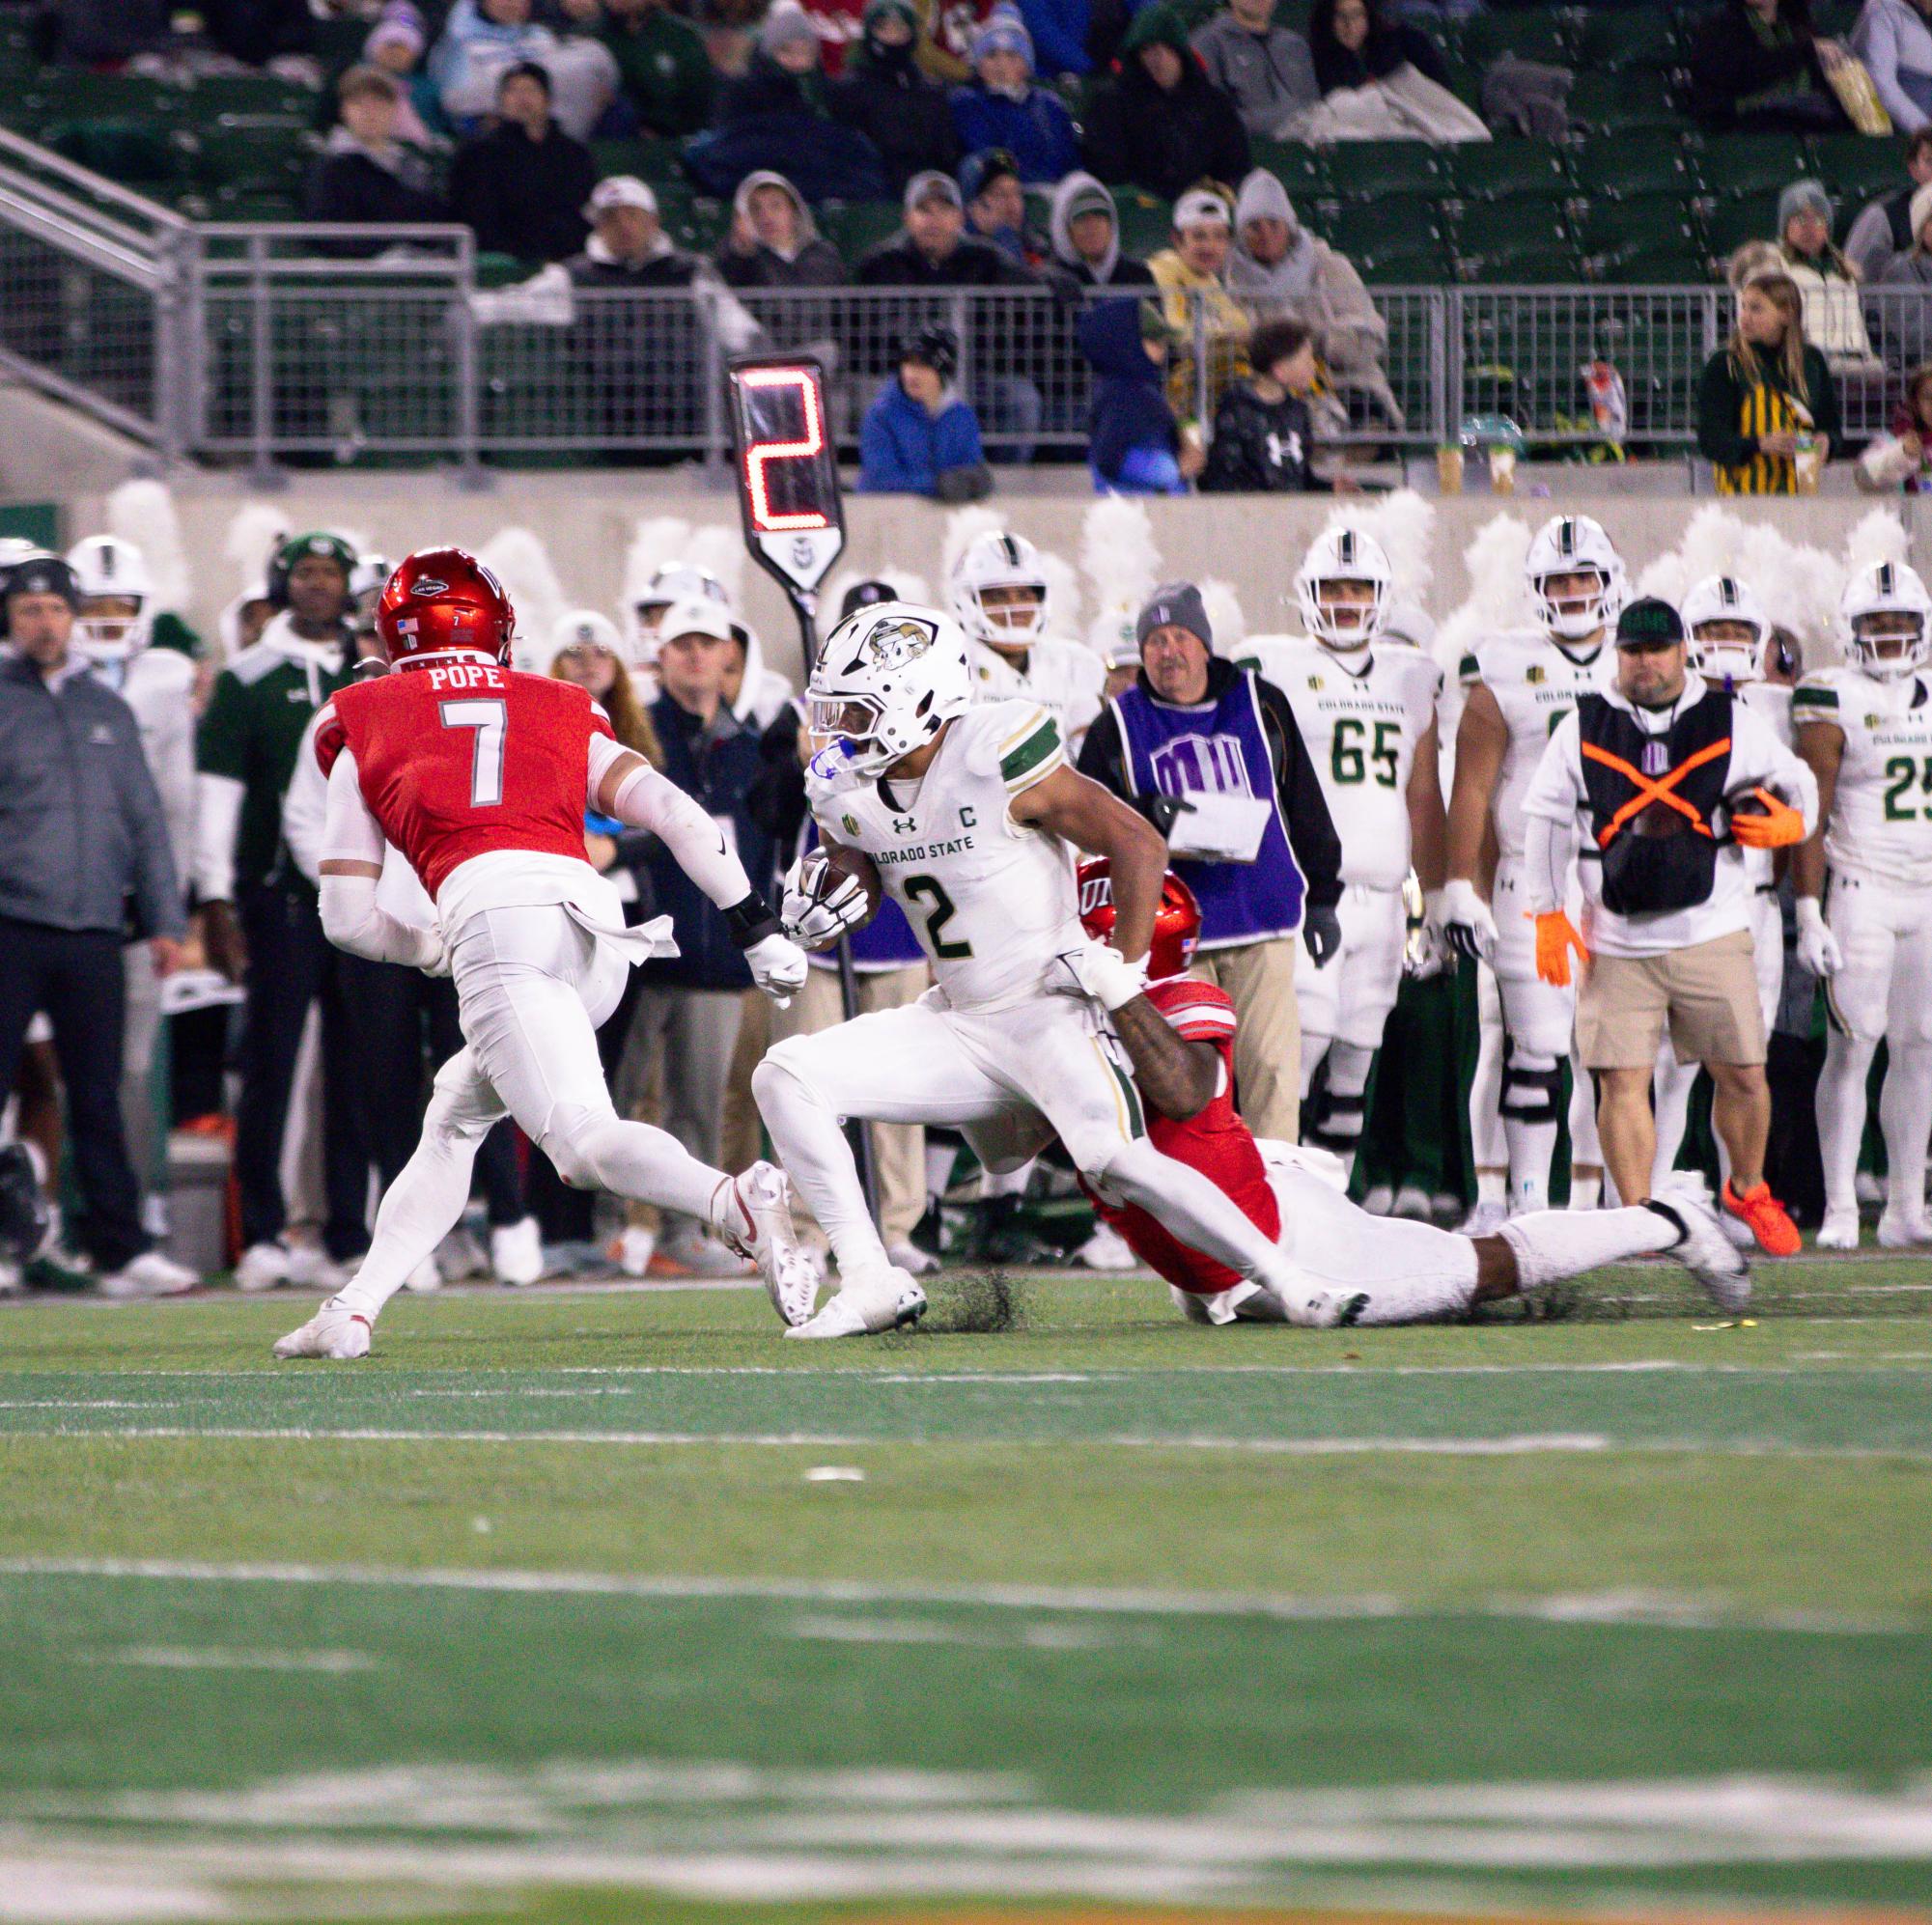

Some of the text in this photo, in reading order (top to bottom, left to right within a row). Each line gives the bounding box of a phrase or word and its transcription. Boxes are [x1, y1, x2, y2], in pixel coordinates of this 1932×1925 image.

[742, 369, 827, 531] 2
[453, 616, 460, 626] 7
[429, 665, 505, 689] POPE
[437, 698, 508, 808] 7
[1331, 718, 1402, 789] 65
[959, 807, 976, 827] C
[929, 836, 974, 858] STATE
[905, 875, 973, 961] 2
